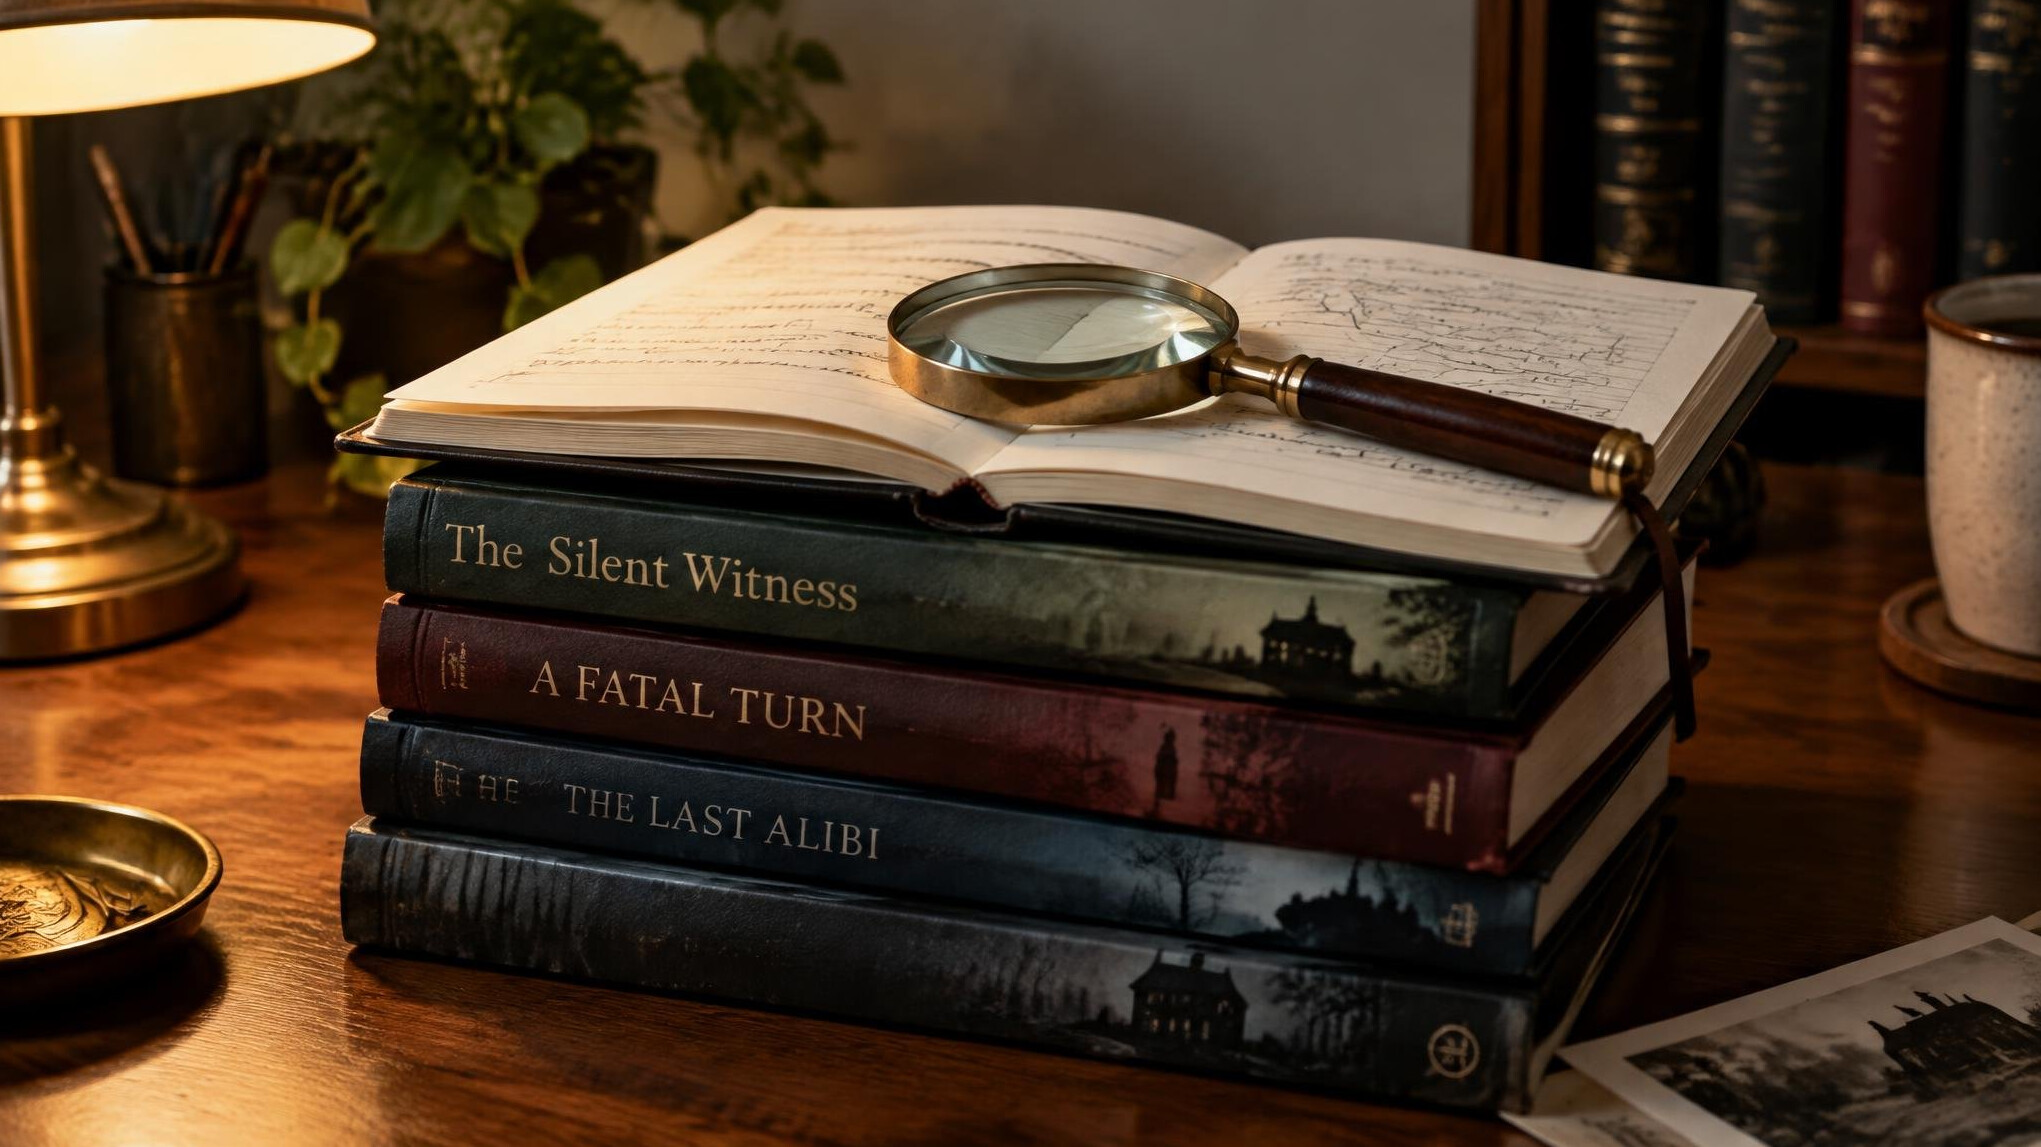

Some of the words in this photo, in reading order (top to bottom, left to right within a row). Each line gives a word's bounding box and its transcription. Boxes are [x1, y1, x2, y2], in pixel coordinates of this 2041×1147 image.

[446, 523, 524, 569] The
[548, 535, 670, 589] Silent
[683, 552, 859, 612] Witness
[529, 660, 561, 697] A
[575, 664, 715, 719] FATAL
[730, 687, 867, 742] TURN
[563, 783, 635, 824] THE
[649, 795, 752, 840] LAST
[764, 814, 881, 860] ALIBI
